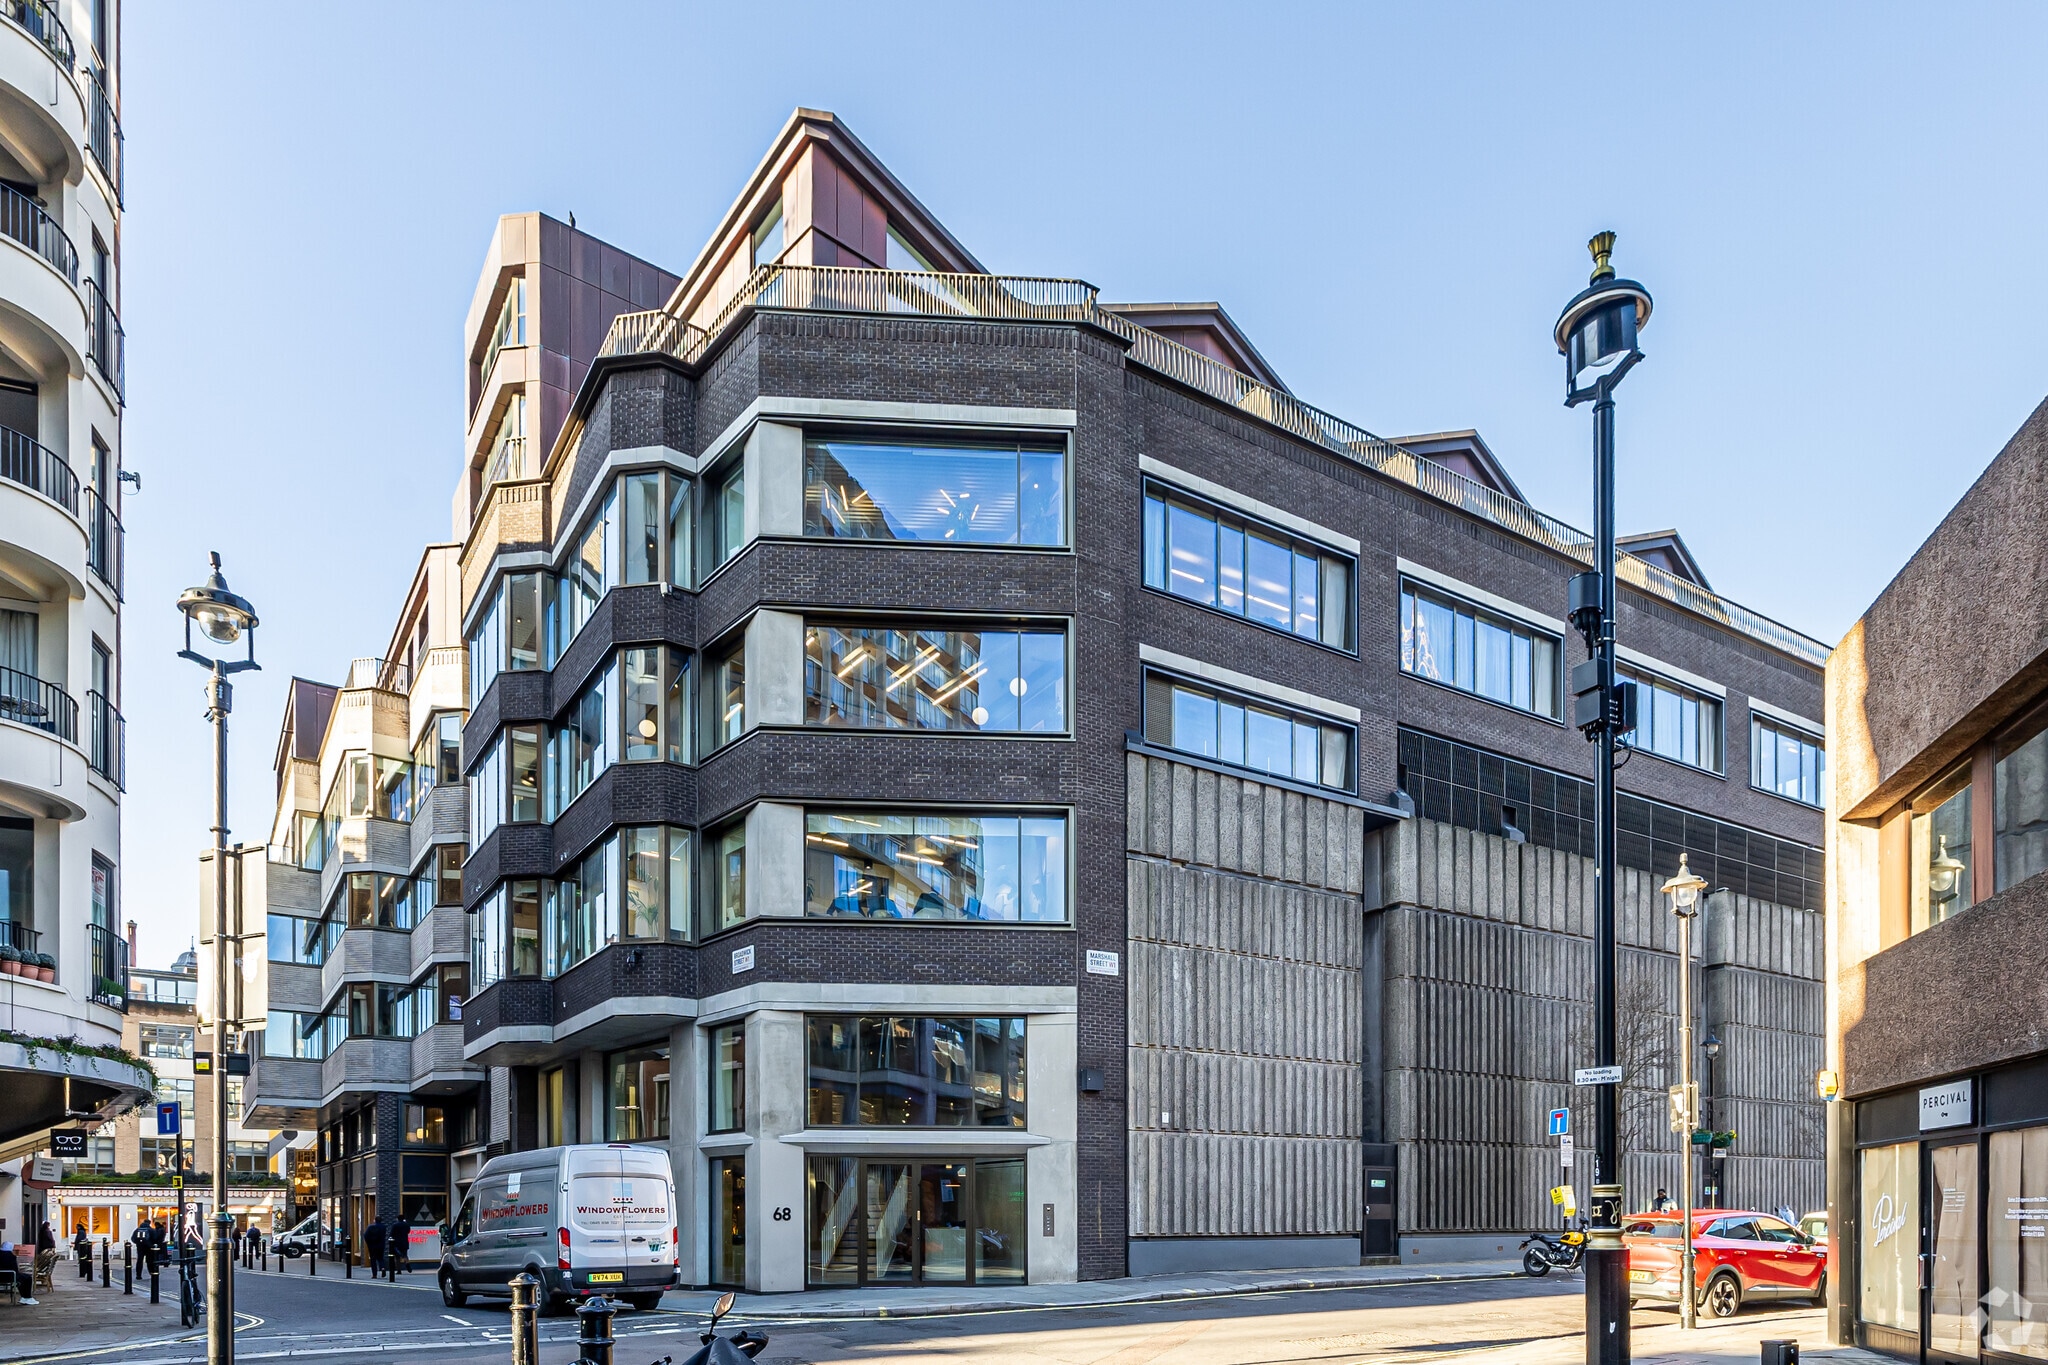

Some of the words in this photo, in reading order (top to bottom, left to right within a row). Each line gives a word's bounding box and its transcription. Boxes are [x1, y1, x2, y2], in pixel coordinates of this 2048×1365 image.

[1090, 953, 1115, 961] MARSHALL
[1923, 1091, 1967, 1108] PERCIVAL
[773, 1206, 791, 1221] 68
[1872, 1192, 1907, 1247] Percival
[592, 1273, 608, 1281] RV74
